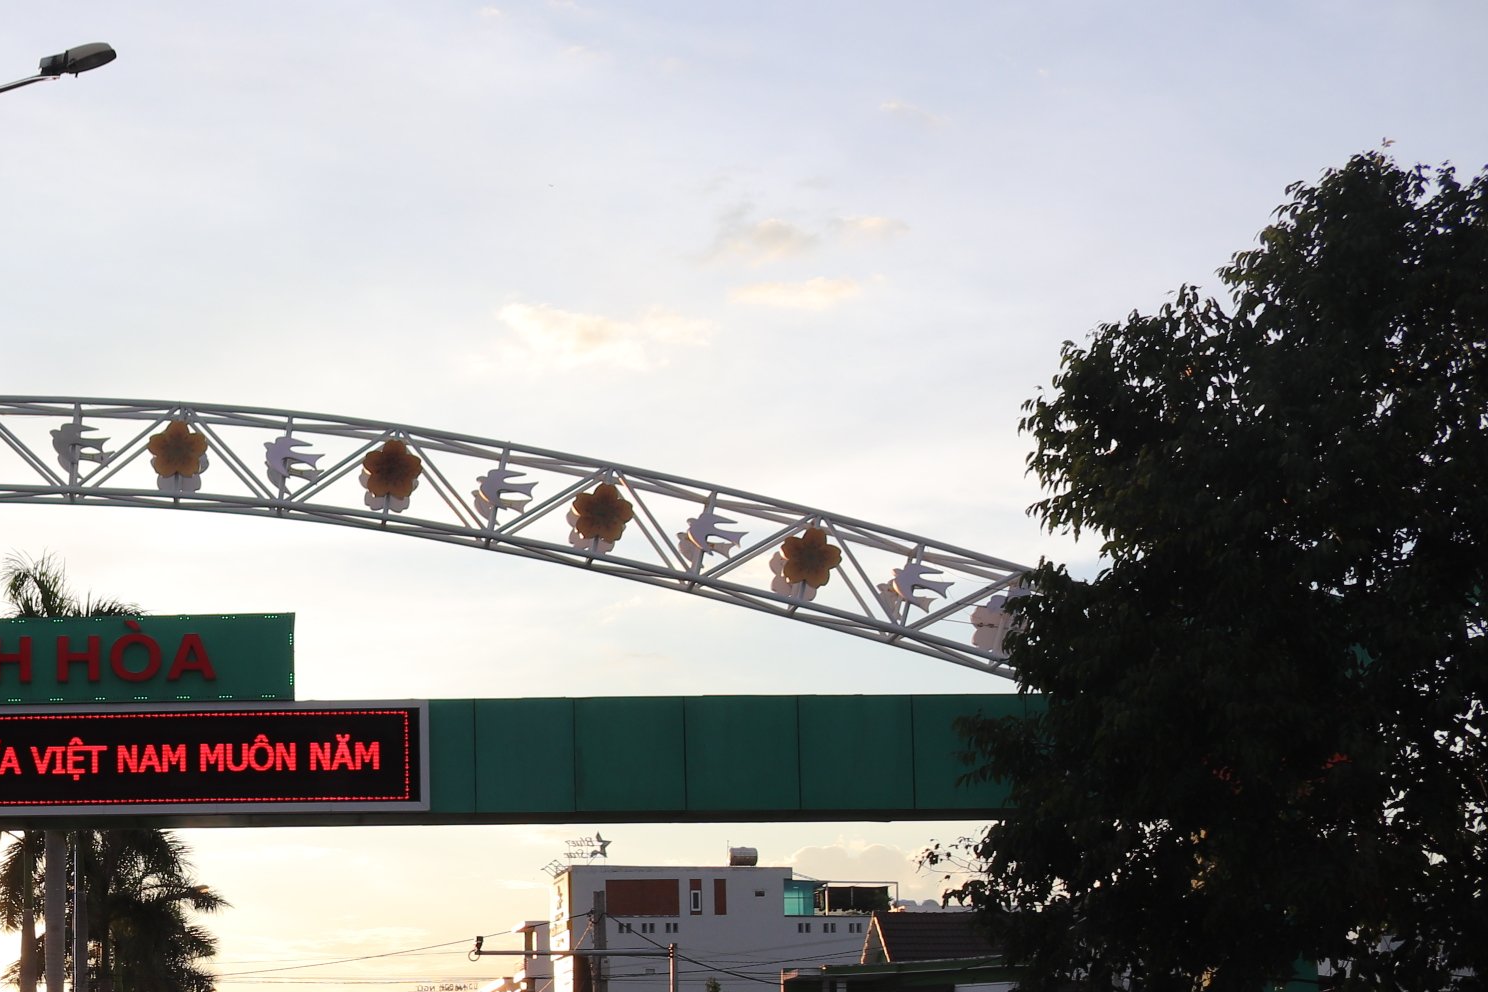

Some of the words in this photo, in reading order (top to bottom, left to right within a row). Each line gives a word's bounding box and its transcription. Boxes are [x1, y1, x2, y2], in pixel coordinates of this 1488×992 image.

[57, 620, 215, 682] HÒA
[31, 737, 108, 781] VIỆT
[117, 744, 187, 773] NAM
[200, 734, 296, 772] MUÔN
[310, 734, 380, 771] NĂM
